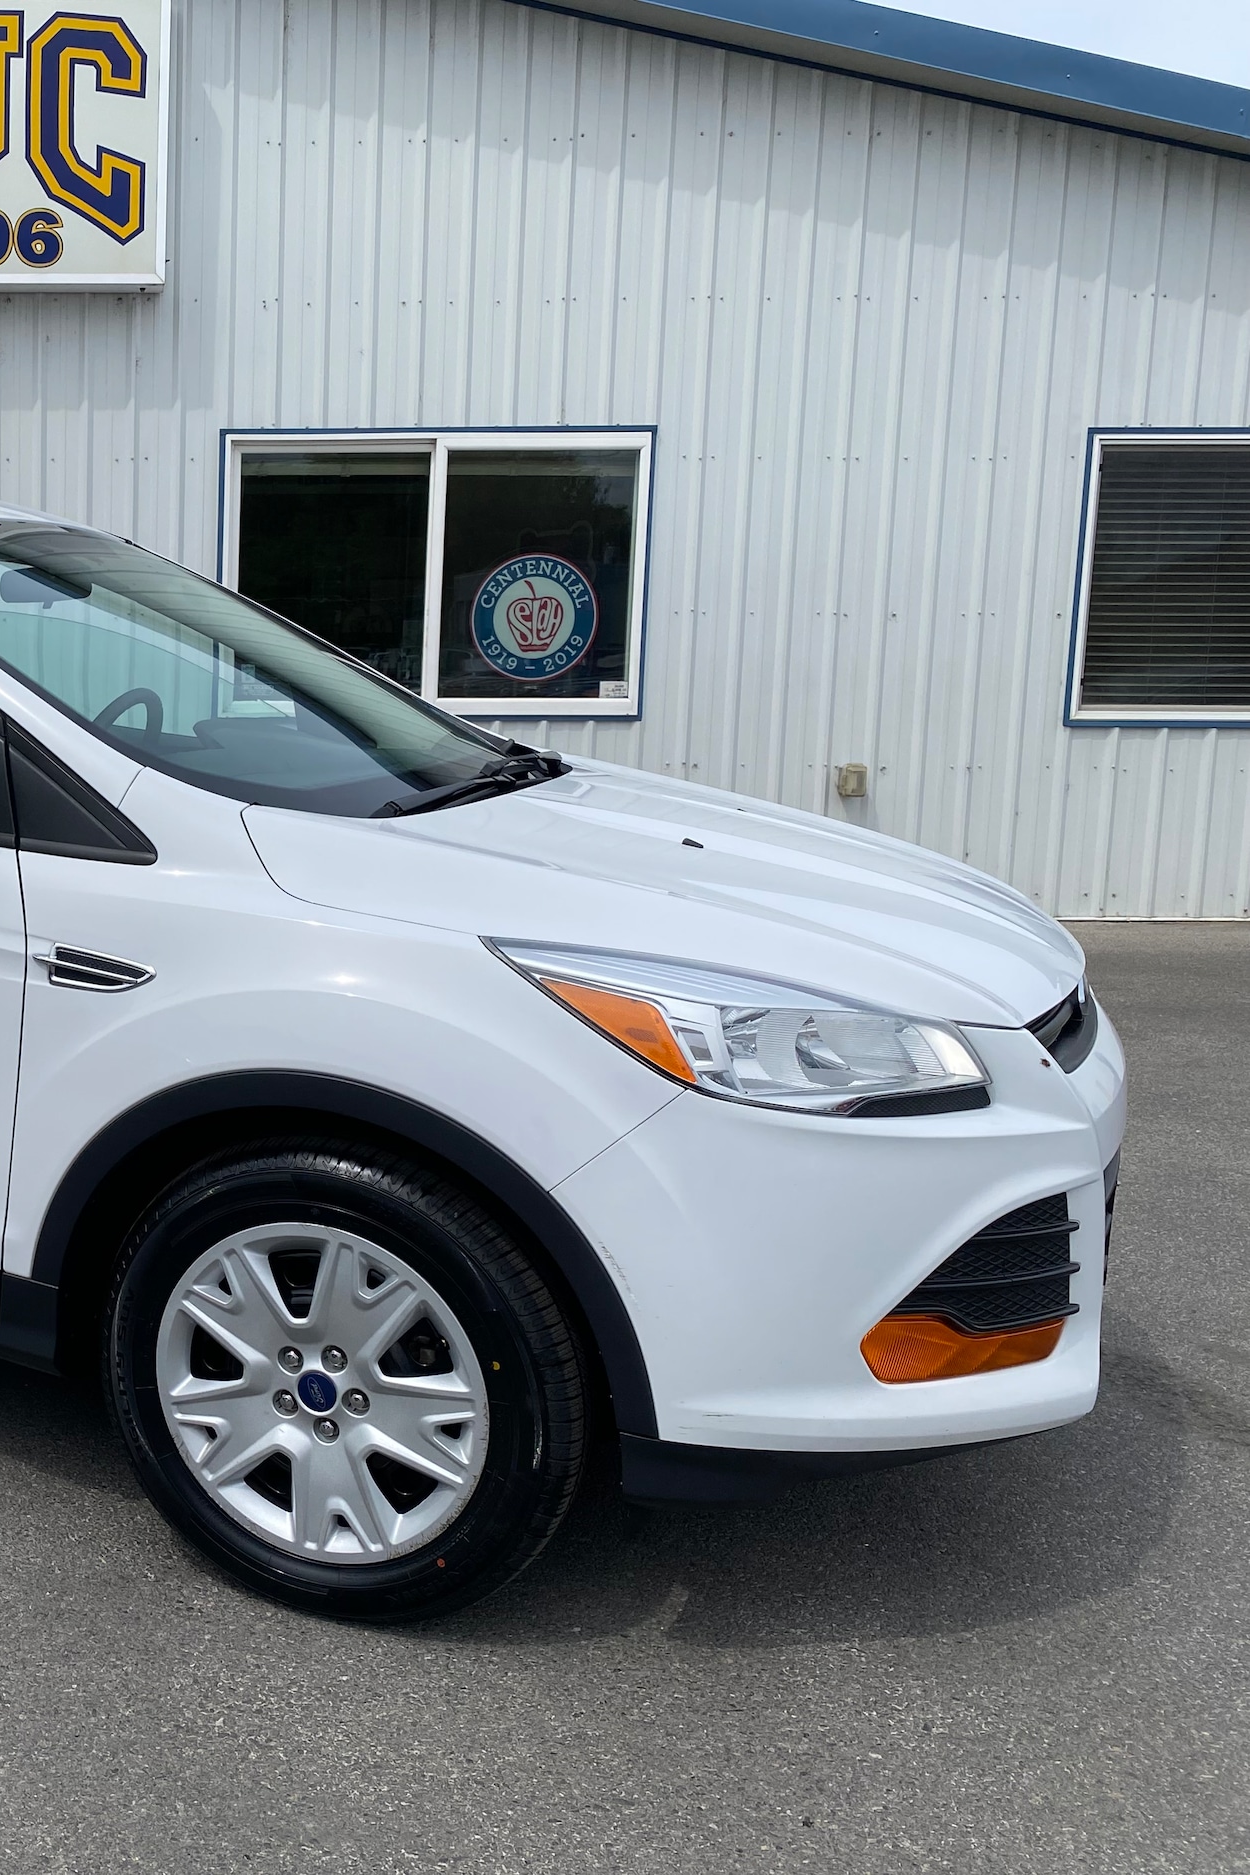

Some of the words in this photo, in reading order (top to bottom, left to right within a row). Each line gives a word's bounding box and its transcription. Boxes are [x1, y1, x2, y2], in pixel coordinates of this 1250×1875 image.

[480, 560, 590, 609] CENTENNIAL
[482, 635, 518, 670] 1919
[543, 635, 584, 673] 2019
